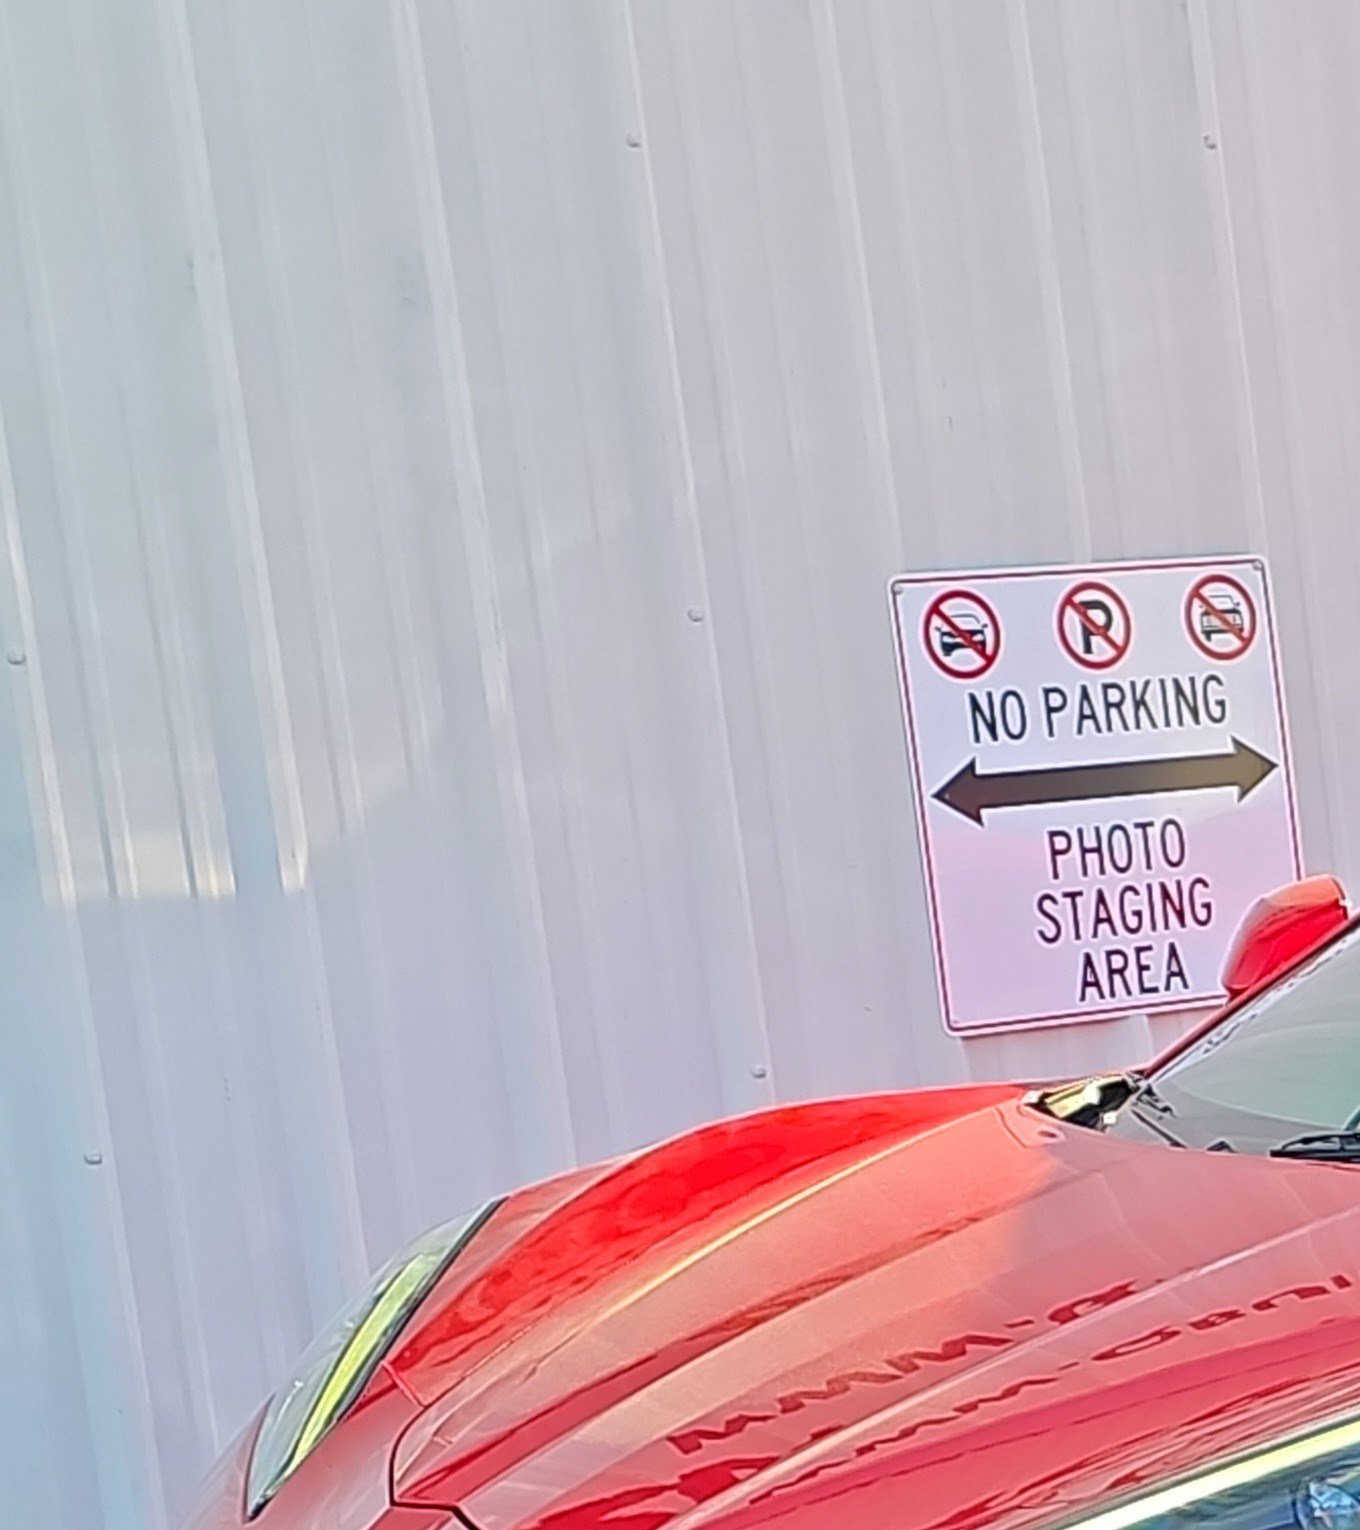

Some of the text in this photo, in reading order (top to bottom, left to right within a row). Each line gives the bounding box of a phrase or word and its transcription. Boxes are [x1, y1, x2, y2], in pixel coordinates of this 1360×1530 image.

[967, 673, 1228, 744] NO PARKING
[1046, 818, 1187, 881] PHOTO
[1036, 878, 1213, 945] STAGING
[1077, 942, 1190, 1003] AREA
